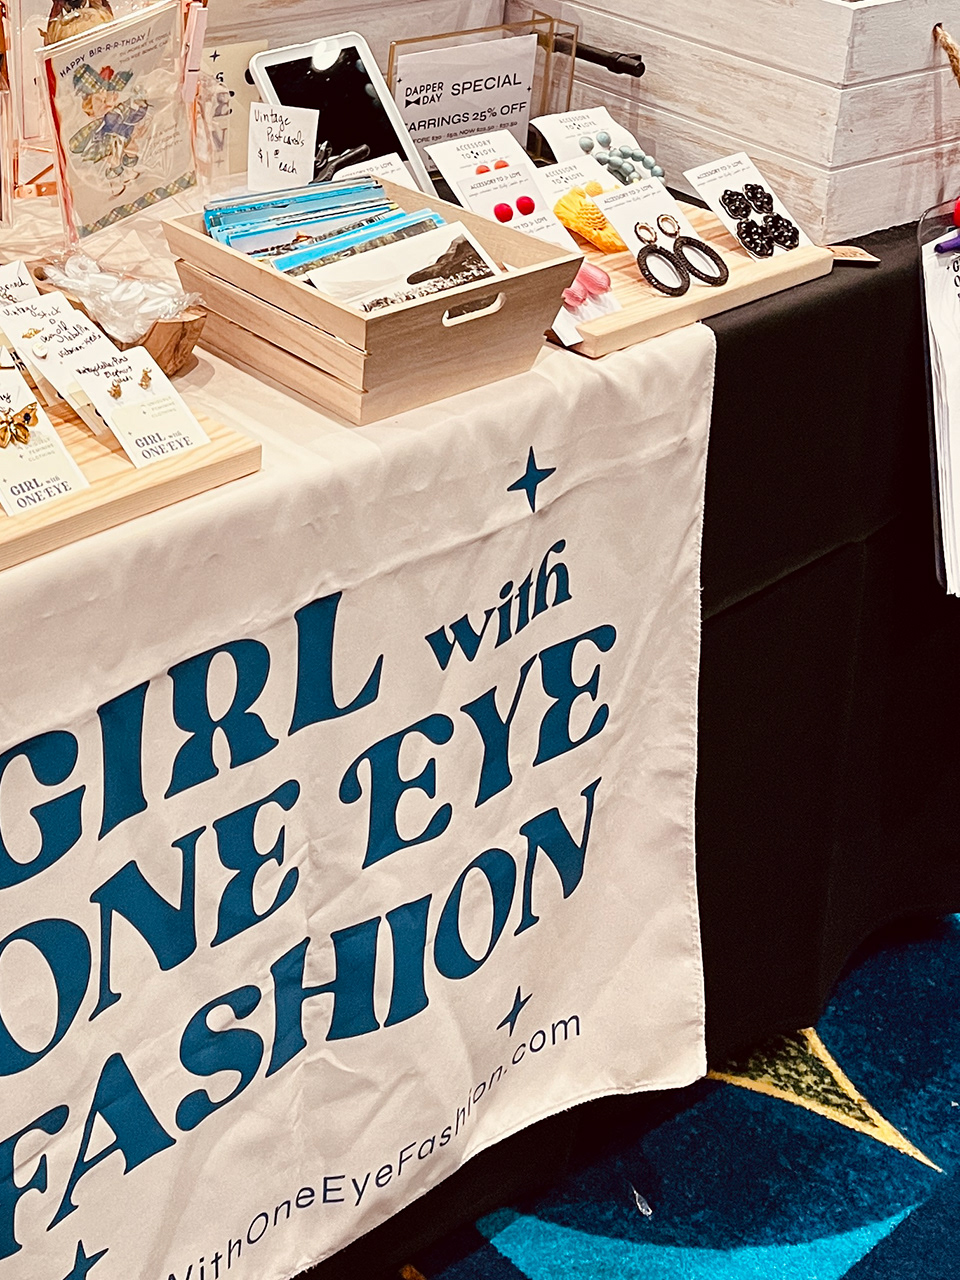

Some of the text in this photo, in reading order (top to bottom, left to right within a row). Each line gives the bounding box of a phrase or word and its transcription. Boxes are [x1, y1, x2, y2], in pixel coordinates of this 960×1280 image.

[60, 54, 86, 78] HAPPY
[405, 82, 444, 97] DAPPER
[451, 73, 522, 96] SPECIAL
[422, 93, 443, 105] DAY
[254, 109, 291, 132] Vintage
[405, 102, 527, 133] ARRINGS 25% OFF
[459, 128, 476, 136] NOW
[456, 139, 491, 152] ACCESSORY
[479, 149, 496, 157] LOVE
[279, 161, 298, 174] each
[470, 178, 496, 190] ACCESSORY
[3, 303, 38, 318] Vintage
[135, 432, 166, 448] GIRL
[141, 436, 193, 460] ONE EYE
[10, 478, 44, 496] GIRL
[16, 480, 72, 508] ONE EYE
[425, 537, 574, 674] with
[339, 623, 617, 869] EYE
